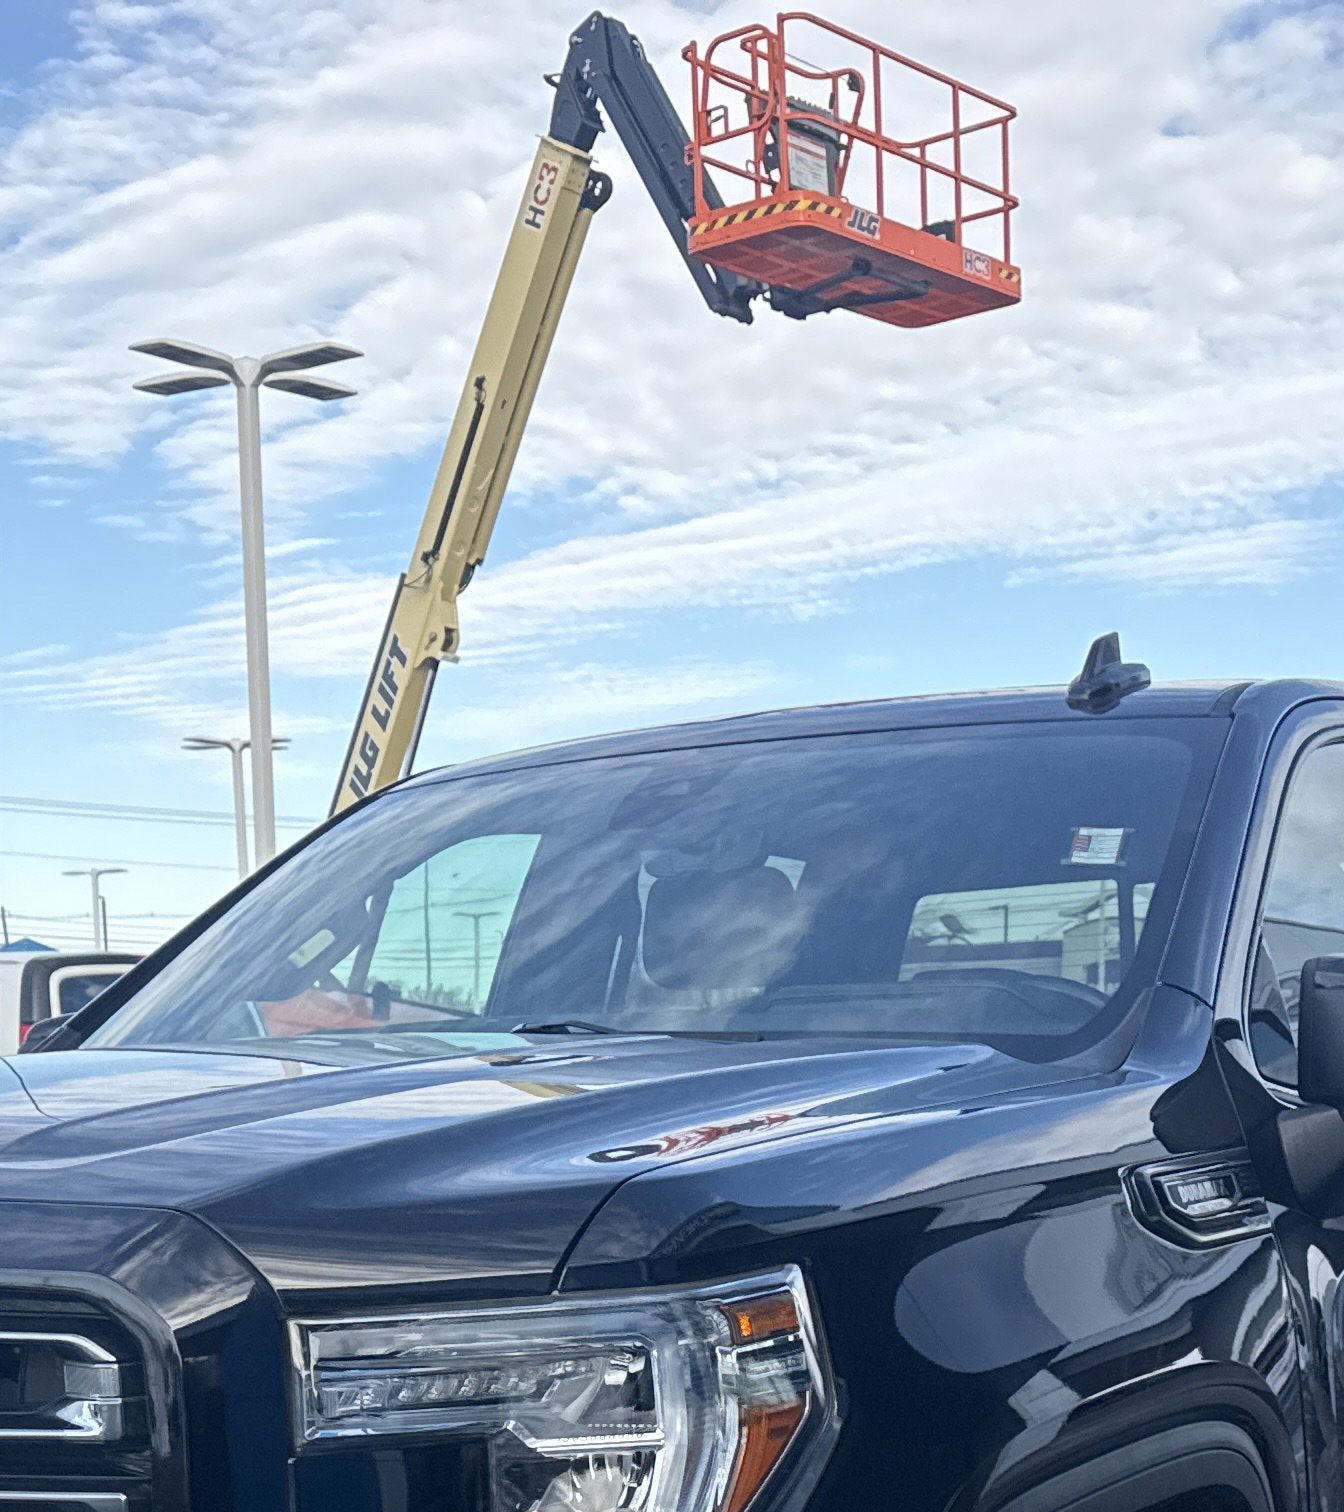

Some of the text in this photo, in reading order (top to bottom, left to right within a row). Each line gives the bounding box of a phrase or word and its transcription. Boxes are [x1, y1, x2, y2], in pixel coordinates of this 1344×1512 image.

[524, 162, 559, 229] HC3
[847, 208, 880, 236] JLG
[963, 251, 991, 277] HC3
[370, 633, 408, 733] LIFT
